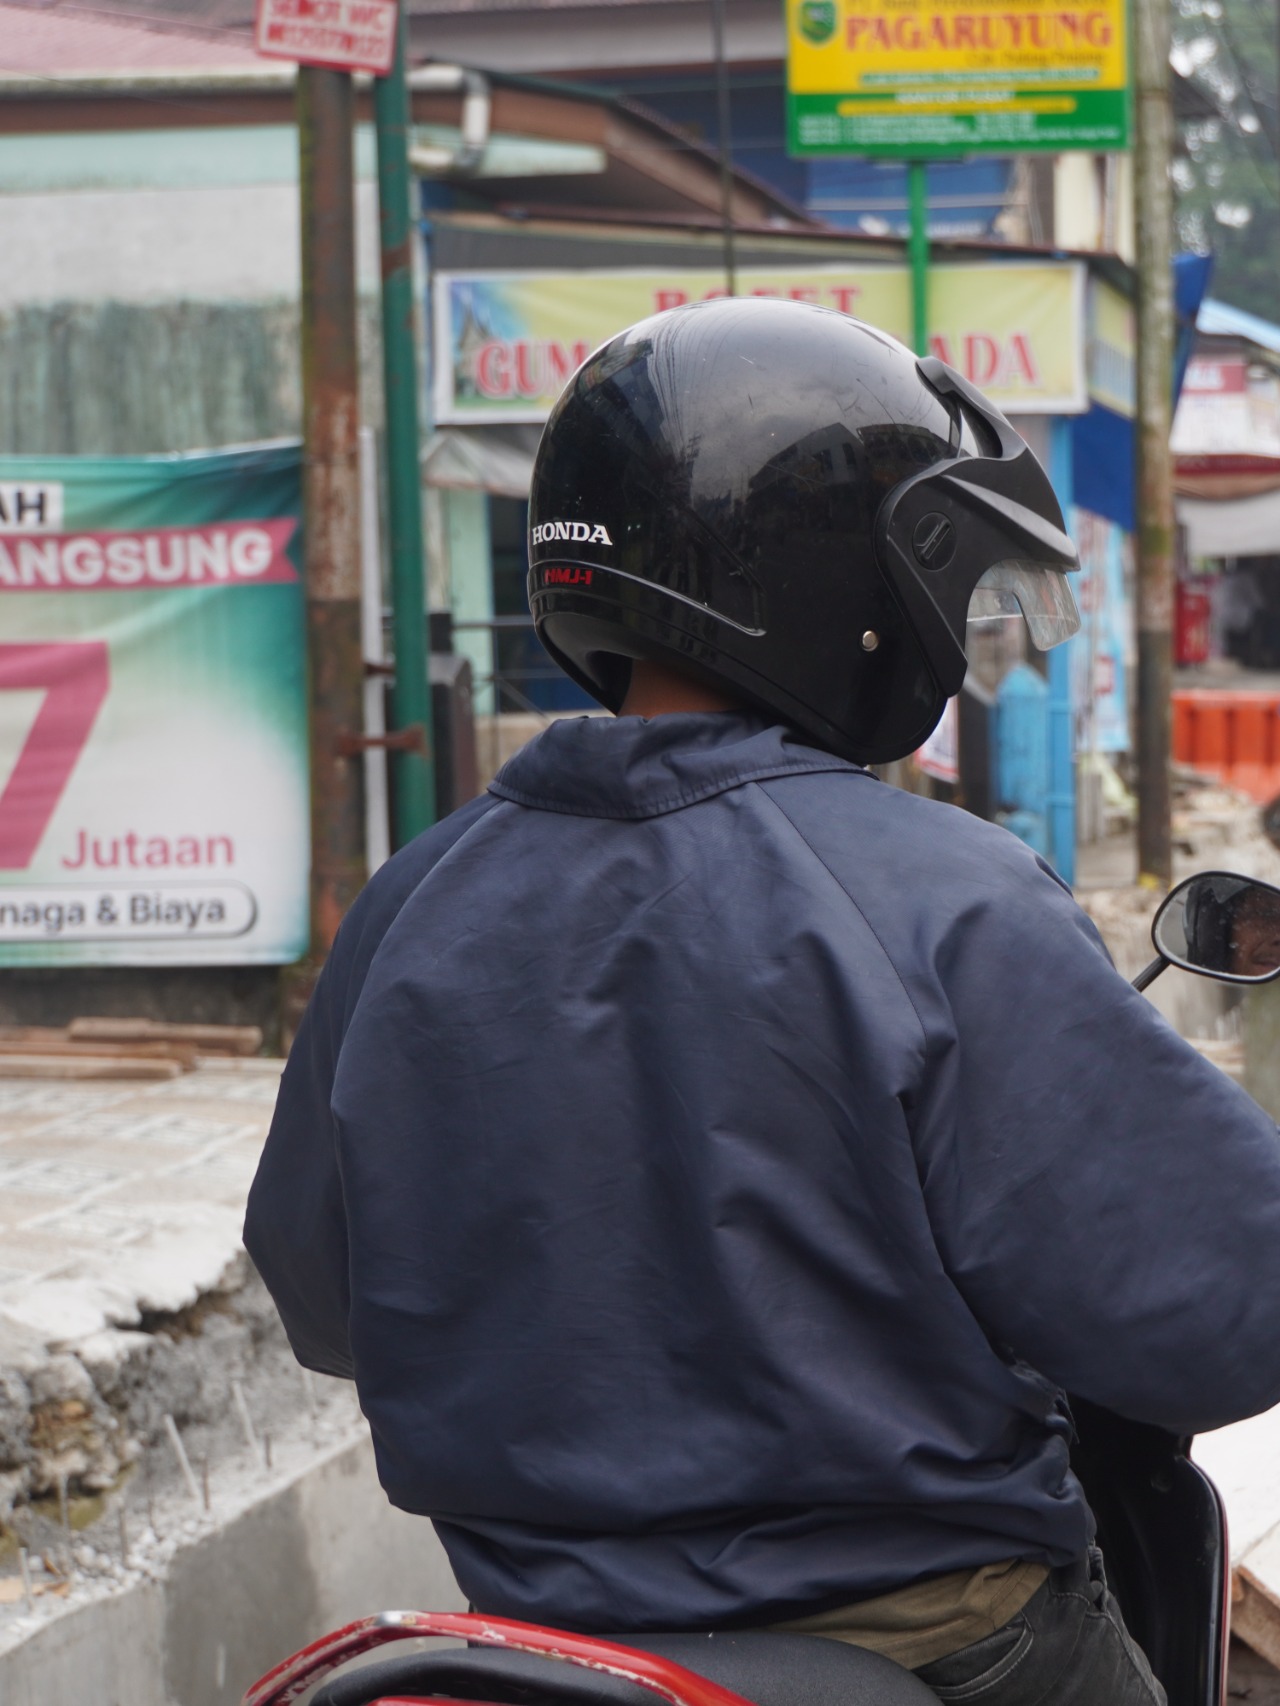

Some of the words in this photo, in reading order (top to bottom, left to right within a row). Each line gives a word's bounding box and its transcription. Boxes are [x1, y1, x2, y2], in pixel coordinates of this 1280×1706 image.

[846, 12, 1112, 51] PAGARUYUNG
[532, 521, 614, 546] HONDA
[61, 829, 236, 870] Jutaan
[96, 894, 119, 925] &
[129, 890, 226, 930] Biaya
